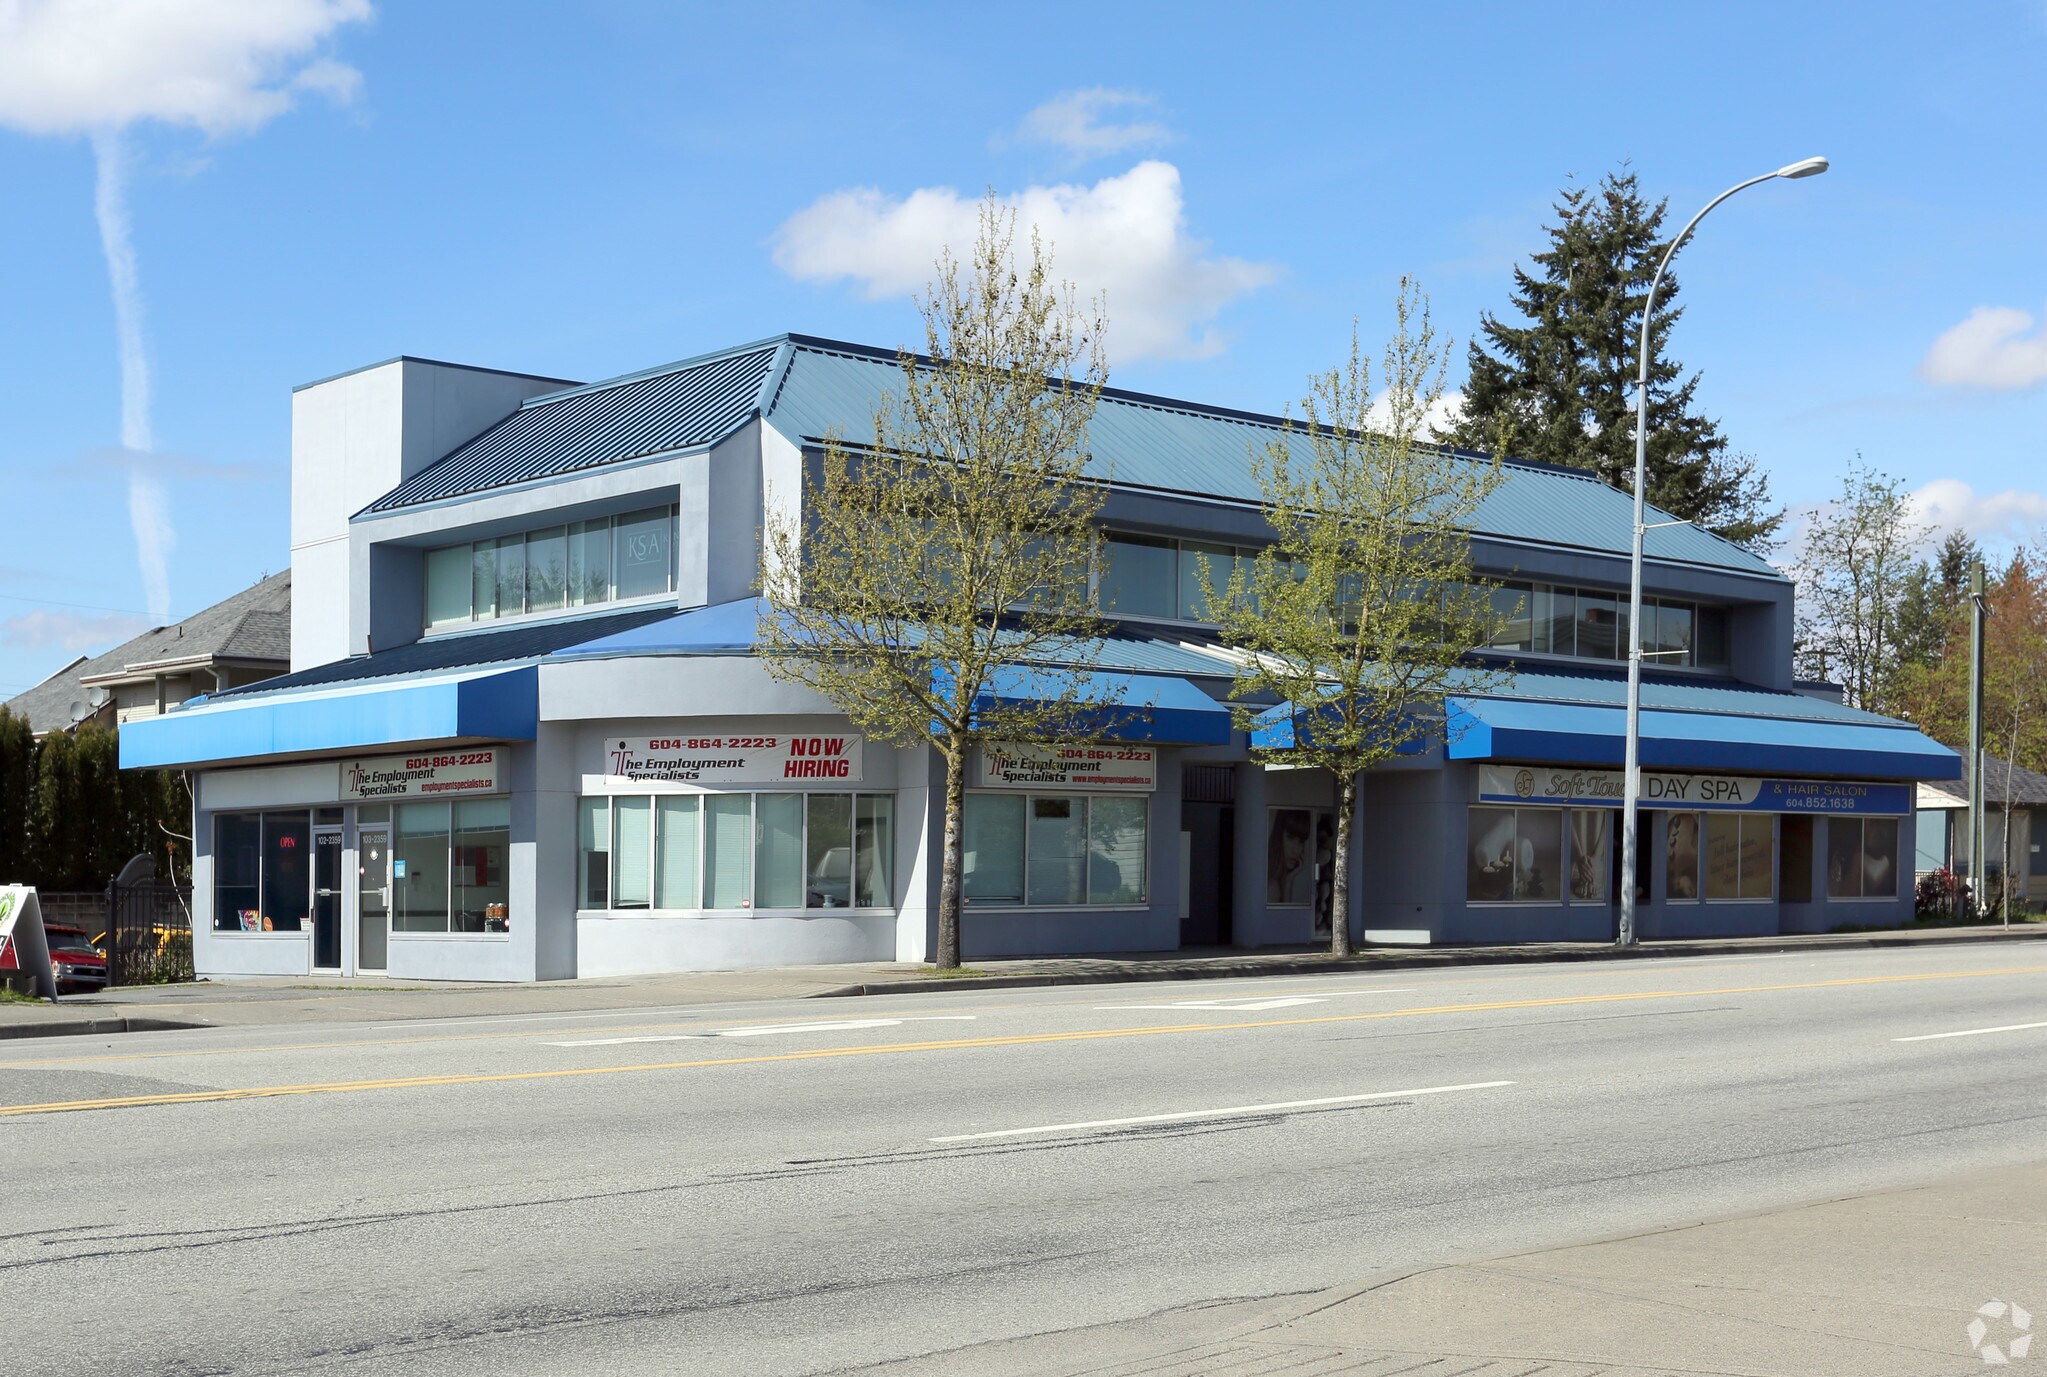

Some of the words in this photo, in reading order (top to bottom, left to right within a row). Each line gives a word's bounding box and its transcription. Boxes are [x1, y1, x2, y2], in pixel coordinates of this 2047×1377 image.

[629, 533, 660, 561] KSA
[649, 738, 777, 750] 604-864-2223
[790, 738, 843, 756] NOW
[406, 752, 493, 769] 604-864-2223
[1057, 749, 1151, 761] 604-864-2223
[611, 750, 643, 775] The
[645, 758, 746, 771] Employment
[784, 759, 849, 778] HIRING
[348, 769, 370, 792] The
[372, 767, 436, 784] Employment
[627, 770, 700, 782] Specialists
[1002, 770, 1067, 784] Specialists
[359, 783, 408, 798] Specialists
[421, 778, 493, 793] employmentspecialists.ca
[1545, 772, 1585, 802] Soft
[1586, 775, 1626, 798] Touc
[1648, 777, 1692, 799] DAY
[1700, 779, 1742, 800] SPA
[1773, 784, 1783, 794] &
[1787, 784, 1819, 795] HAIR
[1823, 785, 1868, 796] SALON
[1786, 797, 1855, 809] 604.852.1638
[280, 836, 295, 848] OPEN
[318, 836, 341, 845] 102-2359
[362, 834, 387, 844] 103-2359
